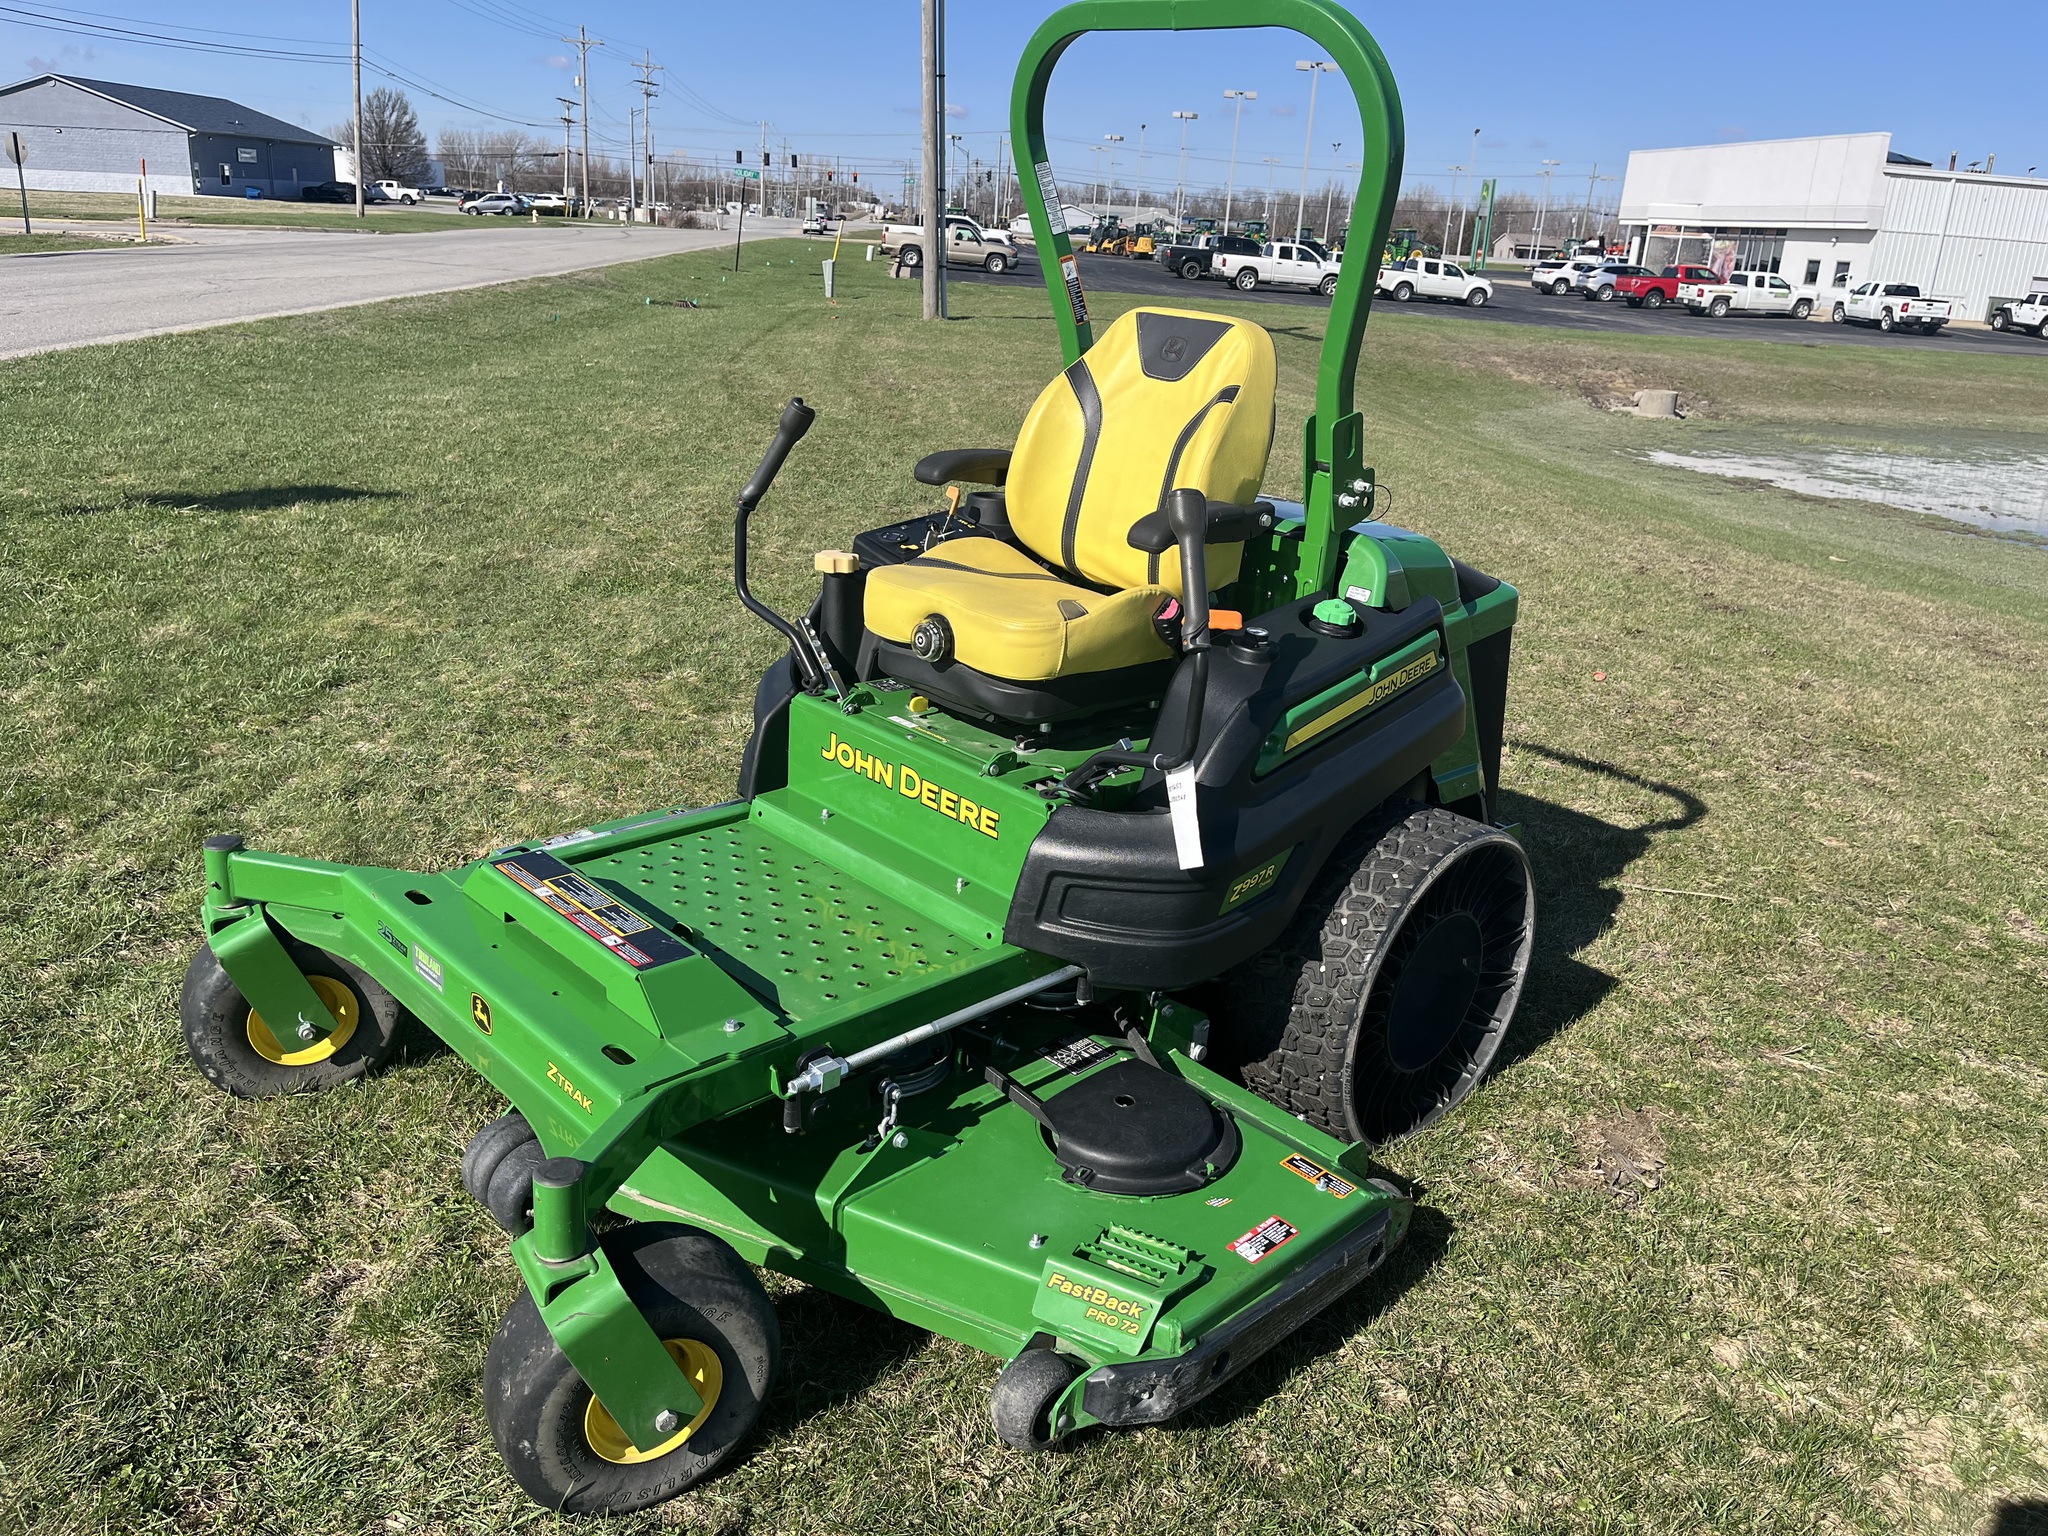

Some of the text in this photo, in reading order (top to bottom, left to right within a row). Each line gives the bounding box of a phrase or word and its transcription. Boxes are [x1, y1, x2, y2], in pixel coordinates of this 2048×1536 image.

[1368, 656, 1433, 707] JOHN DEERE
[821, 731, 1001, 841] JOHN DEERE
[1228, 864, 1275, 904] Z997R
[377, 918, 394, 943] 25
[209, 1011, 257, 1089] RELIANCE
[545, 1059, 595, 1116] ZTRAK
[1046, 1271, 1145, 1321] FastBack
[1085, 1306, 1141, 1337] PRO 72
[603, 1445, 723, 1505] CARLISLE
